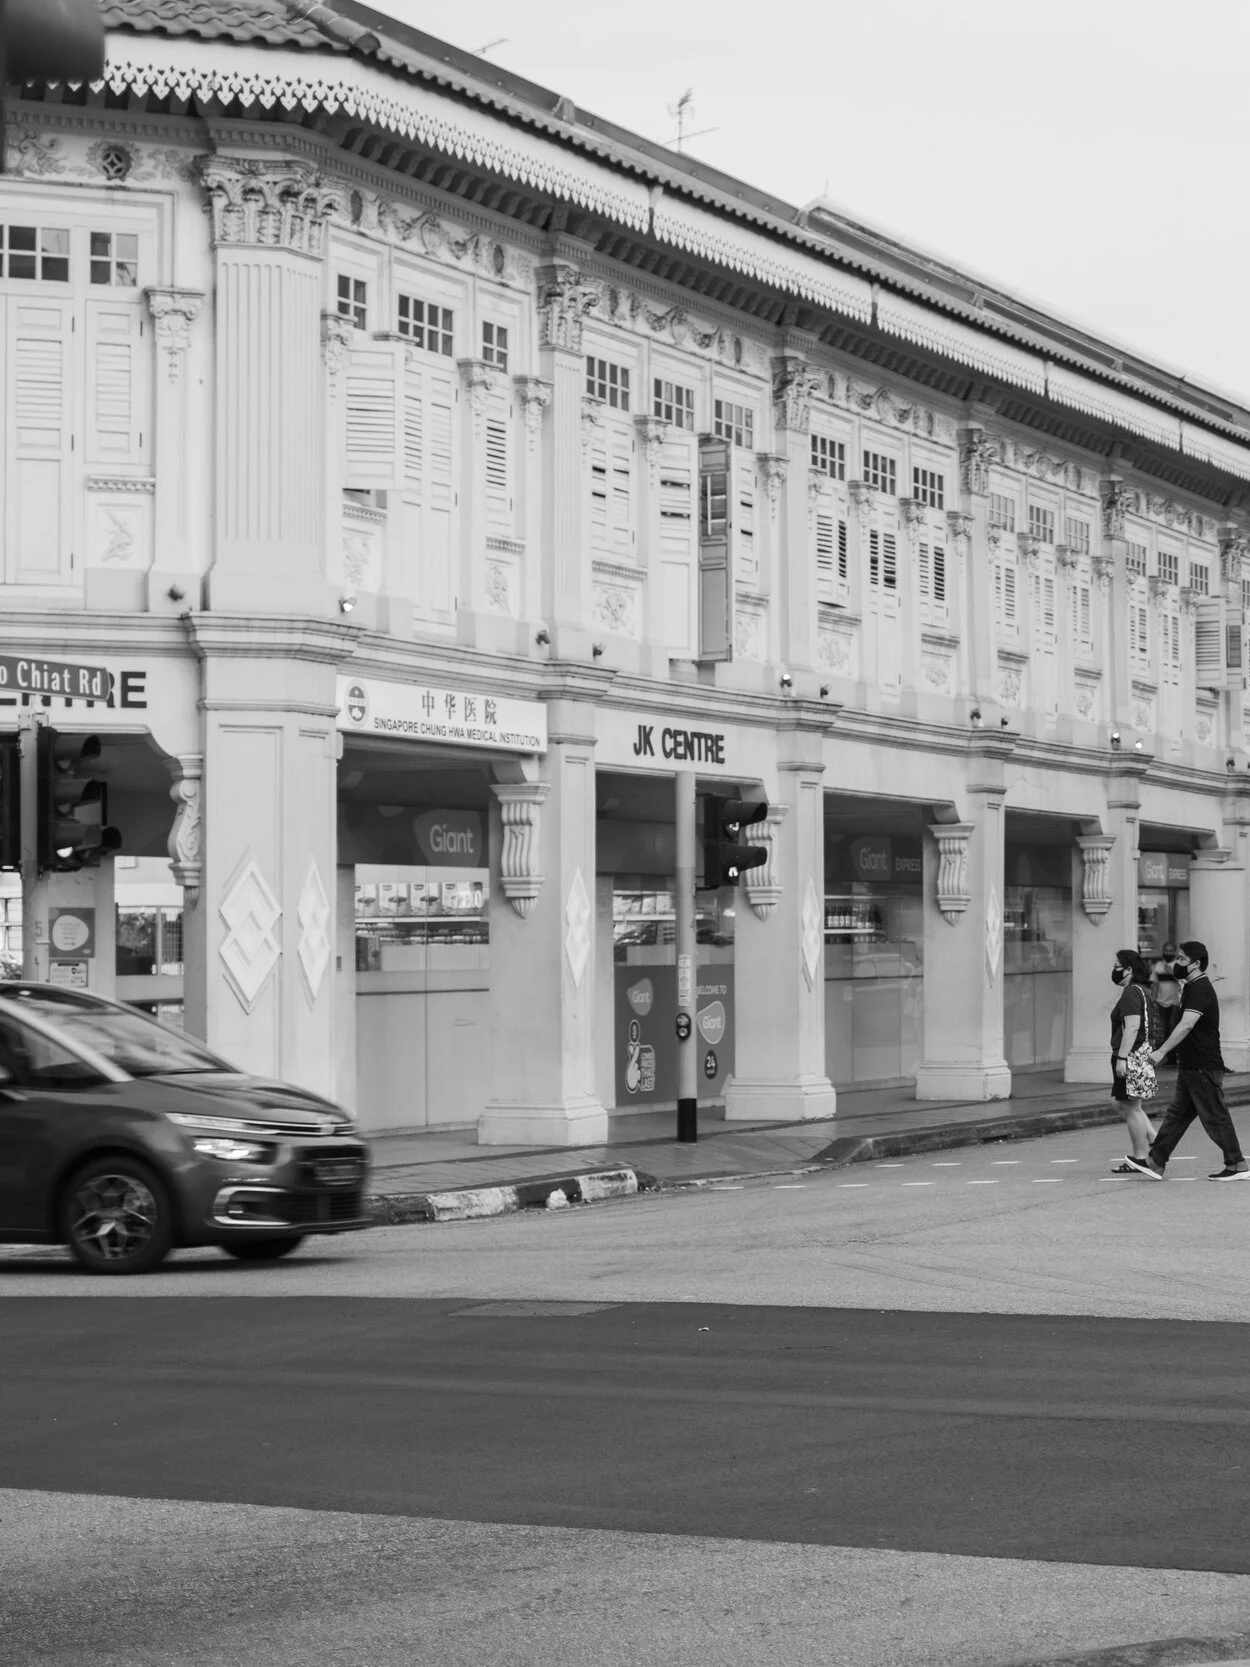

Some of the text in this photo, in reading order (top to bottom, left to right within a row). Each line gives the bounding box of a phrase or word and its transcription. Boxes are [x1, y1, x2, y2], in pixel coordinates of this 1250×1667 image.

[17, 660, 71, 693] Chiat
[79, 668, 102, 696] Rd
[421, 689, 498, 726] 中华医院
[373, 716, 541, 748] SINGAPORE CHUNG HWA MEDICAL INSTITUTION
[633, 725, 725, 765] JK CENTRE
[429, 823, 474, 854] Giant
[860, 847, 888, 872] Giant
[632, 990, 650, 1004] Giant
[702, 1015, 722, 1030] Giant
[706, 1055, 716, 1068] 24
